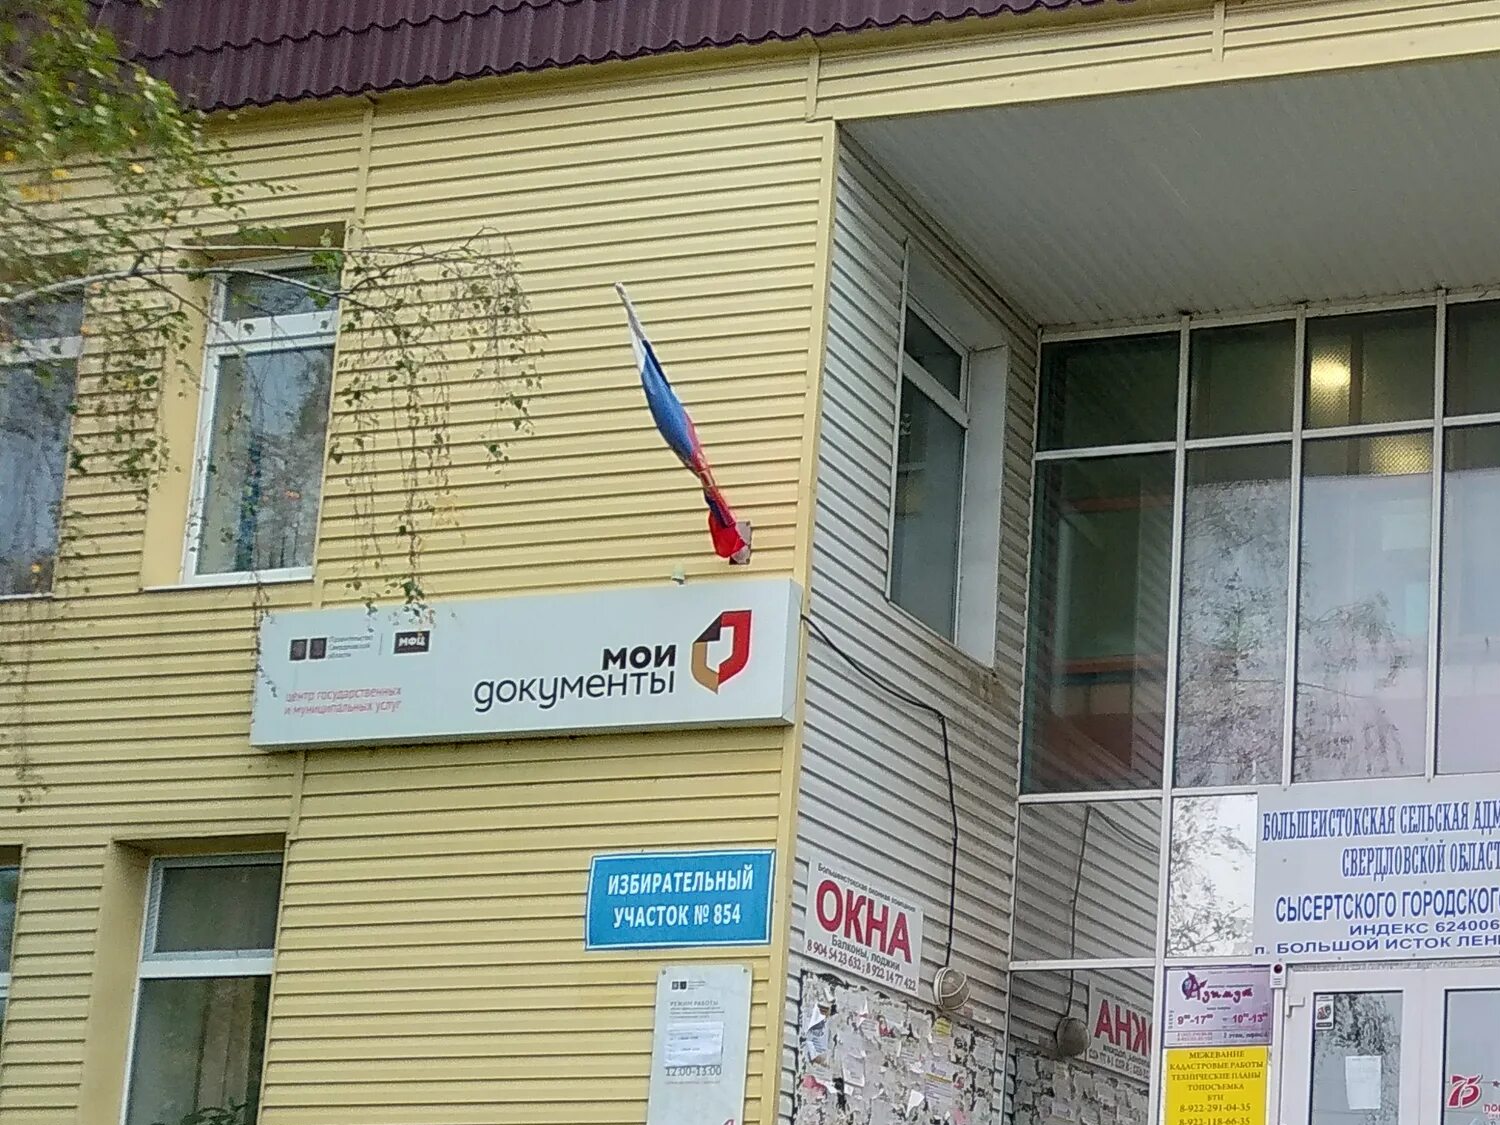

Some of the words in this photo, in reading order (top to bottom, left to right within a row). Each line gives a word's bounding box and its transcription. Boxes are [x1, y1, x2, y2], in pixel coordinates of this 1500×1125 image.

[286, 691, 315, 702] центр
[316, 687, 402, 701] государственных
[474, 670, 675, 713] документы
[284, 707, 291, 715] и
[293, 703, 373, 717] муниципальных
[375, 700, 402, 713] услуг
[1262, 805, 1397, 842] БОЛЬШЕИСТОКСКАЯ
[1400, 801, 1470, 834] СЕЛЬСКАЯ
[1342, 839, 1446, 882] СВЕРДЛОВСКОЙ
[607, 863, 754, 896] ИЗБИРАТЕЛЬНЫЙ
[1276, 891, 1397, 922] СЫСЕРТСКОГО
[613, 905, 690, 929] УЧАСТОК
[693, 904, 710, 926] №
[713, 903, 742, 925] 854
[816, 879, 912, 964] ОКНА
[1349, 923, 1429, 937] ИНДЕКС
[1435, 919, 1500, 933] 624006
[1276, 937, 1379, 954] БОЛЬШОЙ
[1385, 936, 1451, 949] ИСТОК
[1188, 1050, 1246, 1059] МЕЖЕВАНИЕ
[1169, 1062, 1230, 1071] КАДАСТРОВЫЕ
[1230, 1061, 1264, 1069] РАБОТЫ
[1171, 1072, 1230, 1081] ТЕХНИЧЕСКИЕ
[1231, 1071, 1262, 1079] ПЛАНЫ
[1188, 1083, 1245, 1092] ТОПОСЪЕМКА
[1448, 1074, 1481, 1107] 75
[1207, 1094, 1225, 1102] БТИ
[1179, 1102, 1251, 1113] 8-922-291-04-35
